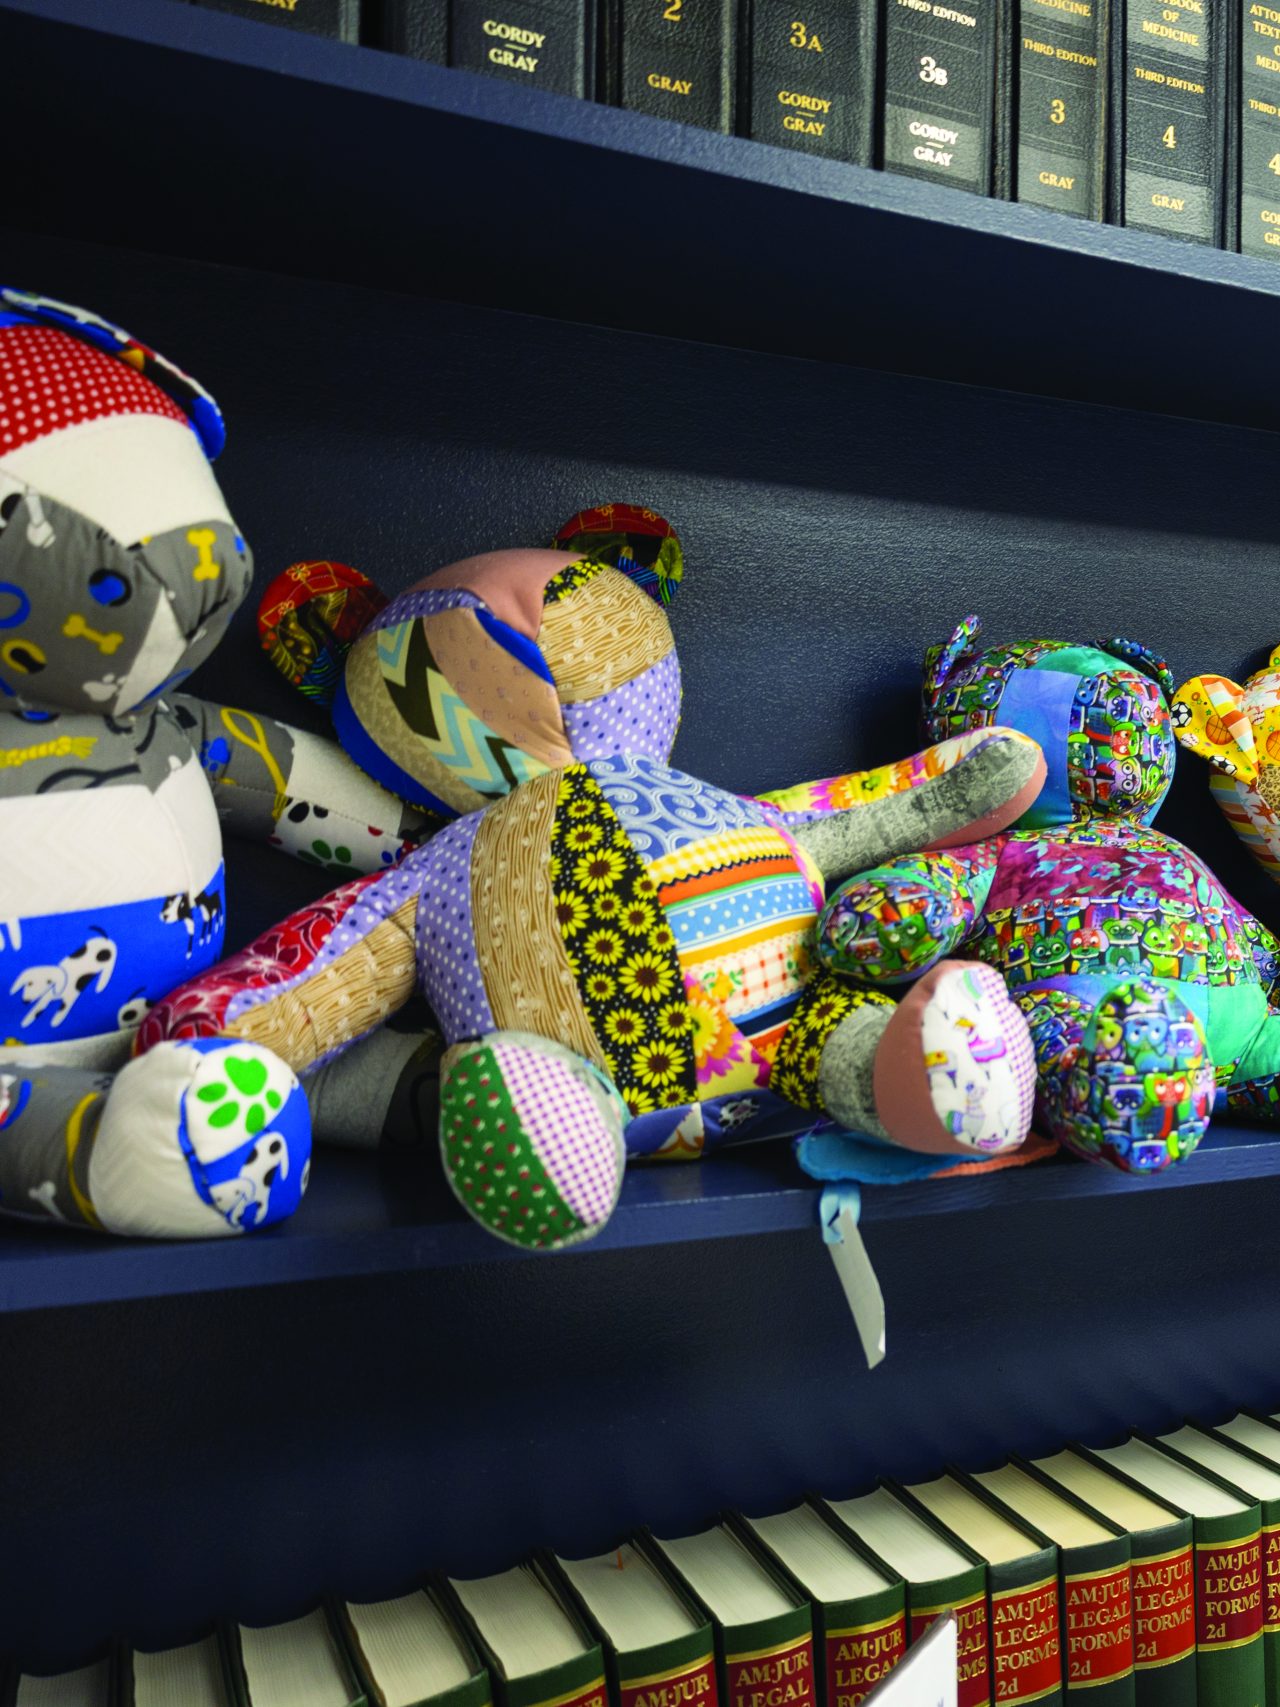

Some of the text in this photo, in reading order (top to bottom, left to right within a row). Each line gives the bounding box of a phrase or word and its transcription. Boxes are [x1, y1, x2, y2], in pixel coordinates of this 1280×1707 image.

[1162, 9, 1180, 23] OF
[482, 20, 546, 49] GORDY
[789, 21, 823, 52] 3A
[1142, 20, 1201, 47] MEDICINE
[488, 48, 539, 73] GRAY
[1023, 37, 1098, 67] THIRD EDITION
[919, 56, 948, 86] 3B
[647, 73, 692, 95] GRAY
[777, 90, 832, 114] GORDY
[1050, 99, 1066, 125] 3
[1248, 99, 1276, 116] THIRD
[783, 116, 826, 137] GRAY
[909, 121, 959, 145] GORDY
[1162, 125, 1177, 149] 4
[913, 146, 953, 167] GRAY
[1039, 171, 1075, 190] GRAY
[1151, 194, 1185, 211] GRAY
[1205, 1568, 1260, 1594] LEGAL
[1135, 1581, 1192, 1612] LEGAL
[1206, 1591, 1260, 1617] FORMS
[1069, 1600, 1131, 1630] LEGAL
[1136, 1604, 1192, 1635] FORMS
[1070, 1622, 1132, 1655] FORMS
[1206, 1623, 1226, 1640] 2d
[1137, 1642, 1158, 1659] 2d
[1071, 1660, 1092, 1677] 2d
